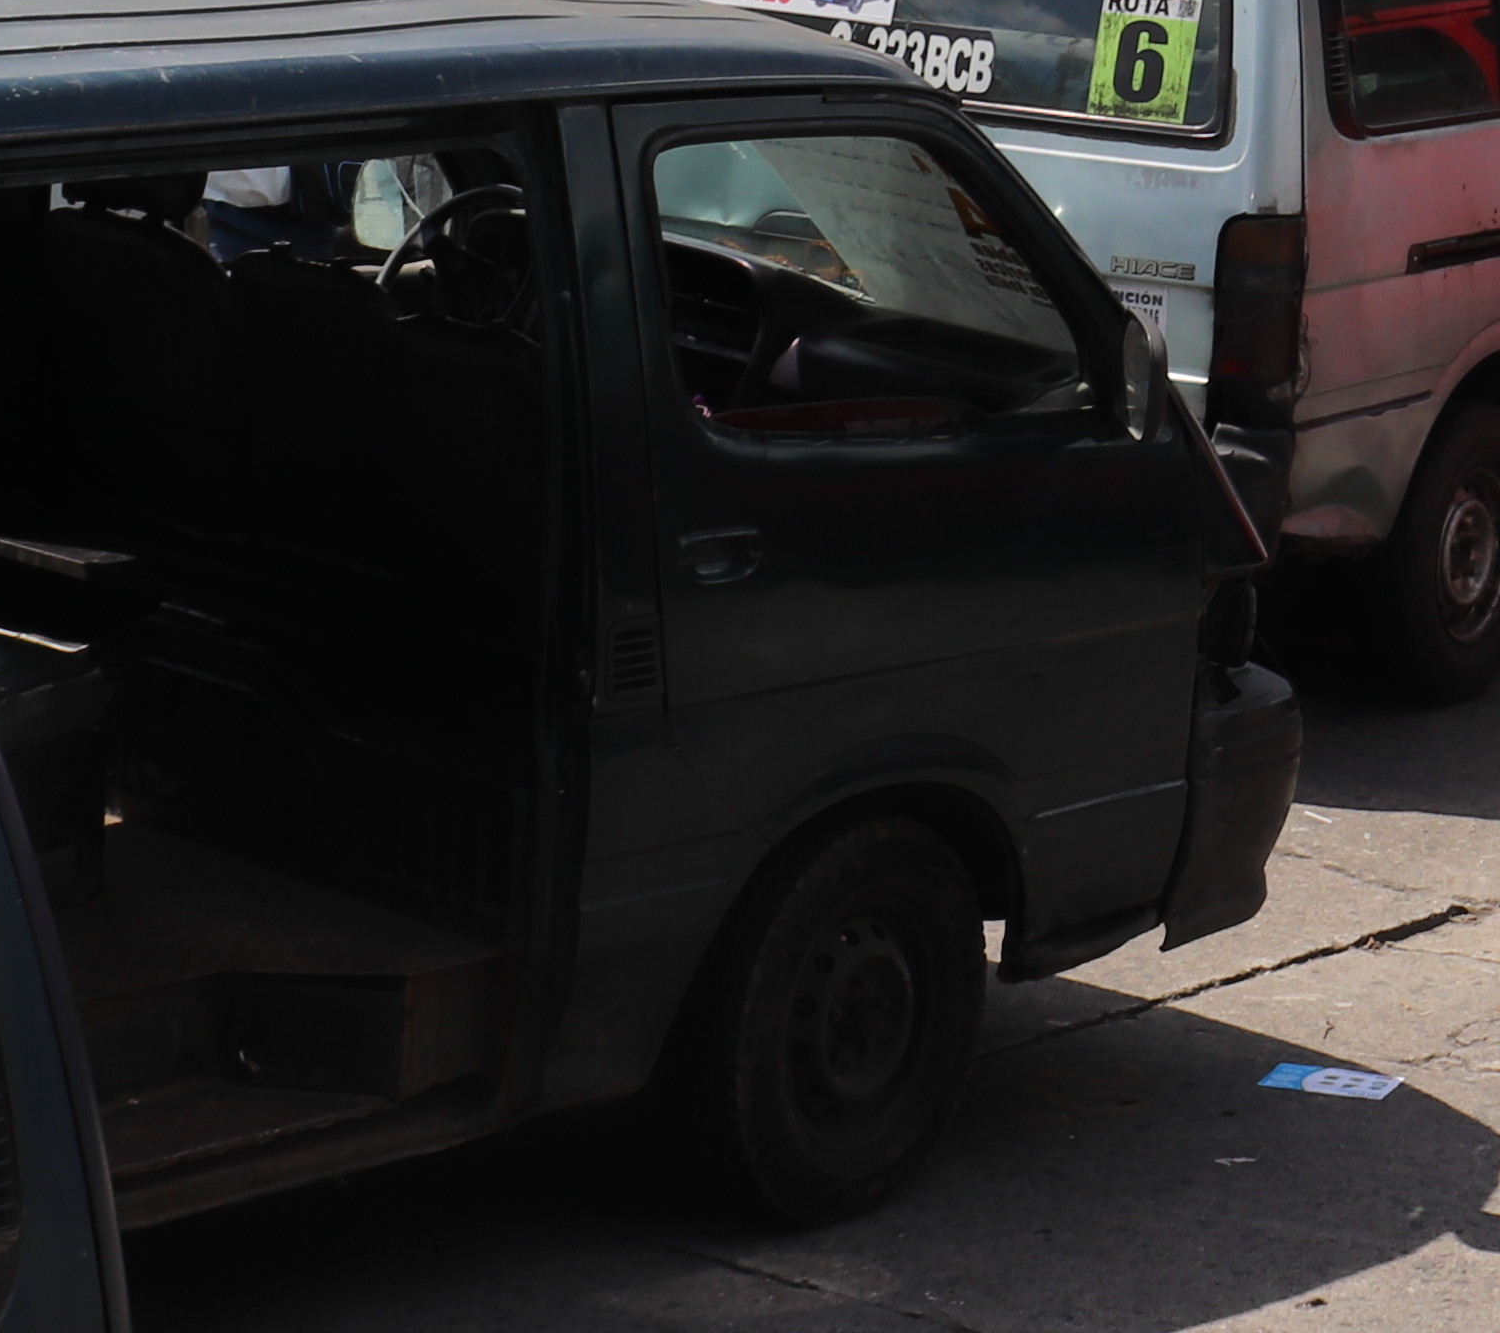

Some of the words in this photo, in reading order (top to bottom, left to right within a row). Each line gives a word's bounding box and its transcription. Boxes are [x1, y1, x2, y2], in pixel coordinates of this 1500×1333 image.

[1113, 20, 1168, 103] 6
[1111, 256, 1195, 280] HIACE
[1113, 290, 1163, 305] NCIÓN
